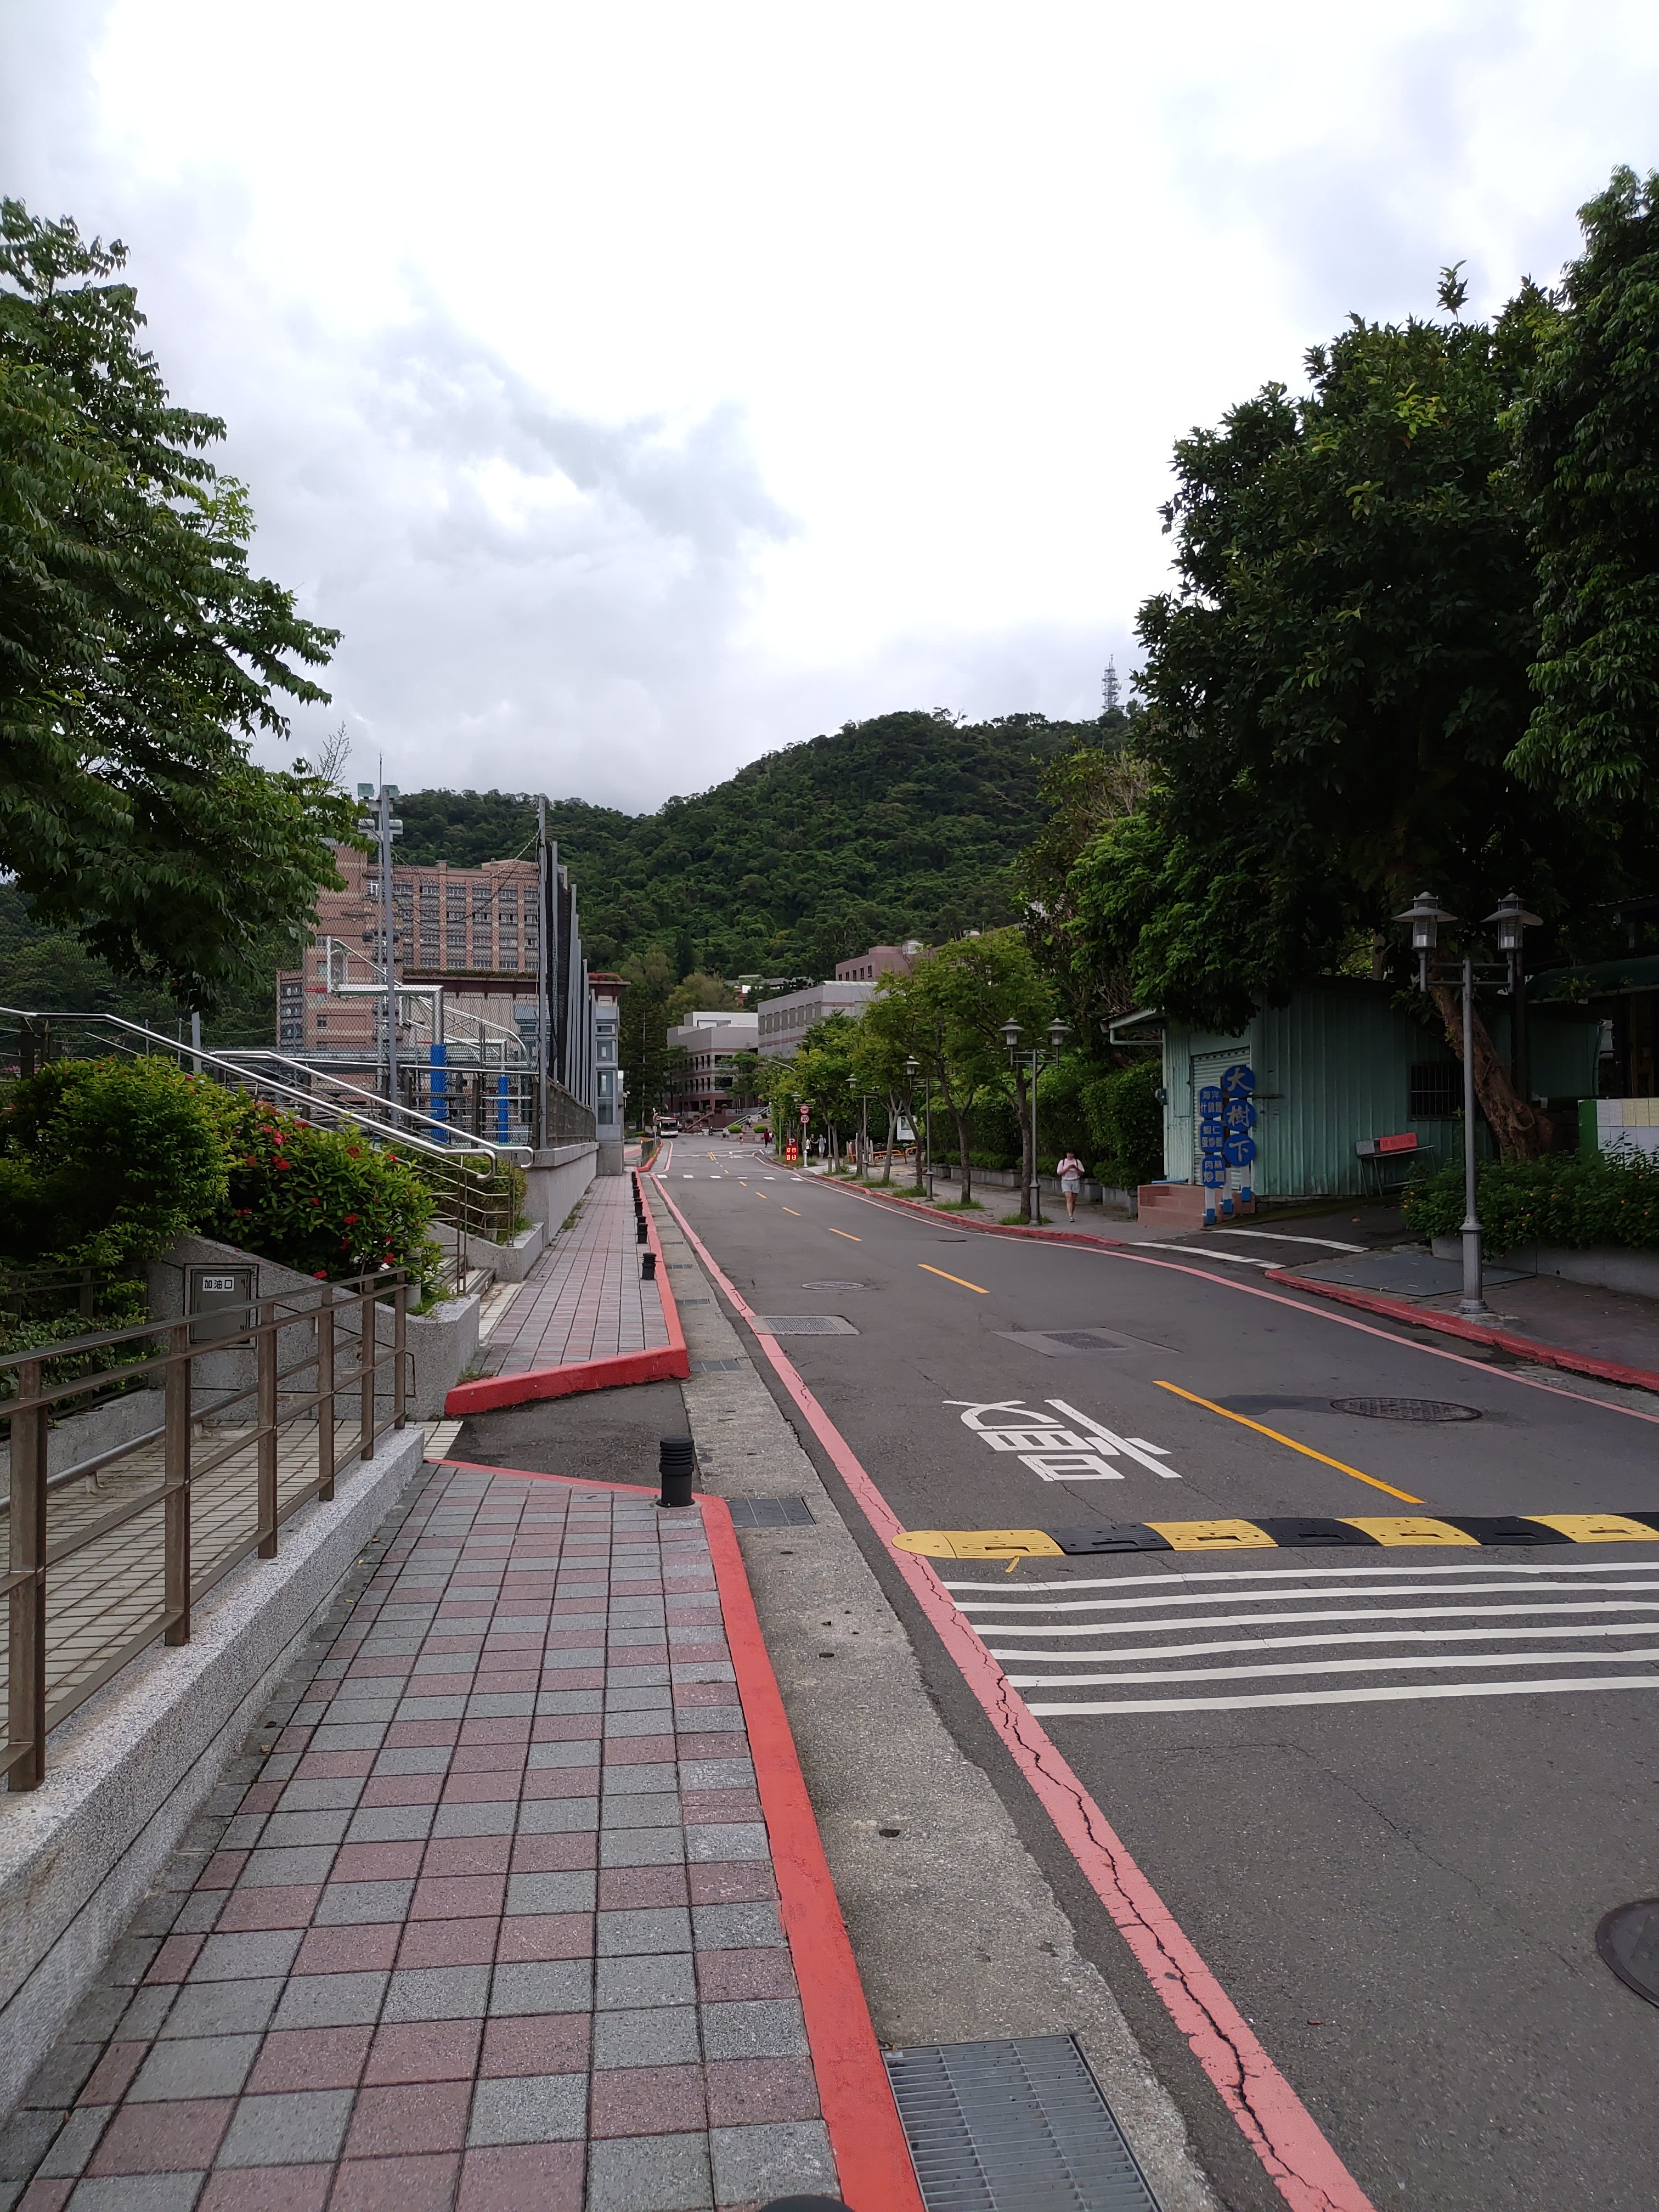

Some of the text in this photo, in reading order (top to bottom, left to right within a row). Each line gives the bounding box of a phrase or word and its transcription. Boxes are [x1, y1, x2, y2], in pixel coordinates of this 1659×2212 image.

[1227, 1067, 1253, 1163] 大樹下
[788, 1138, 795, 1146] P
[204, 1279, 233, 1289] 加油口
[942, 1399, 1183, 1481] 慢
